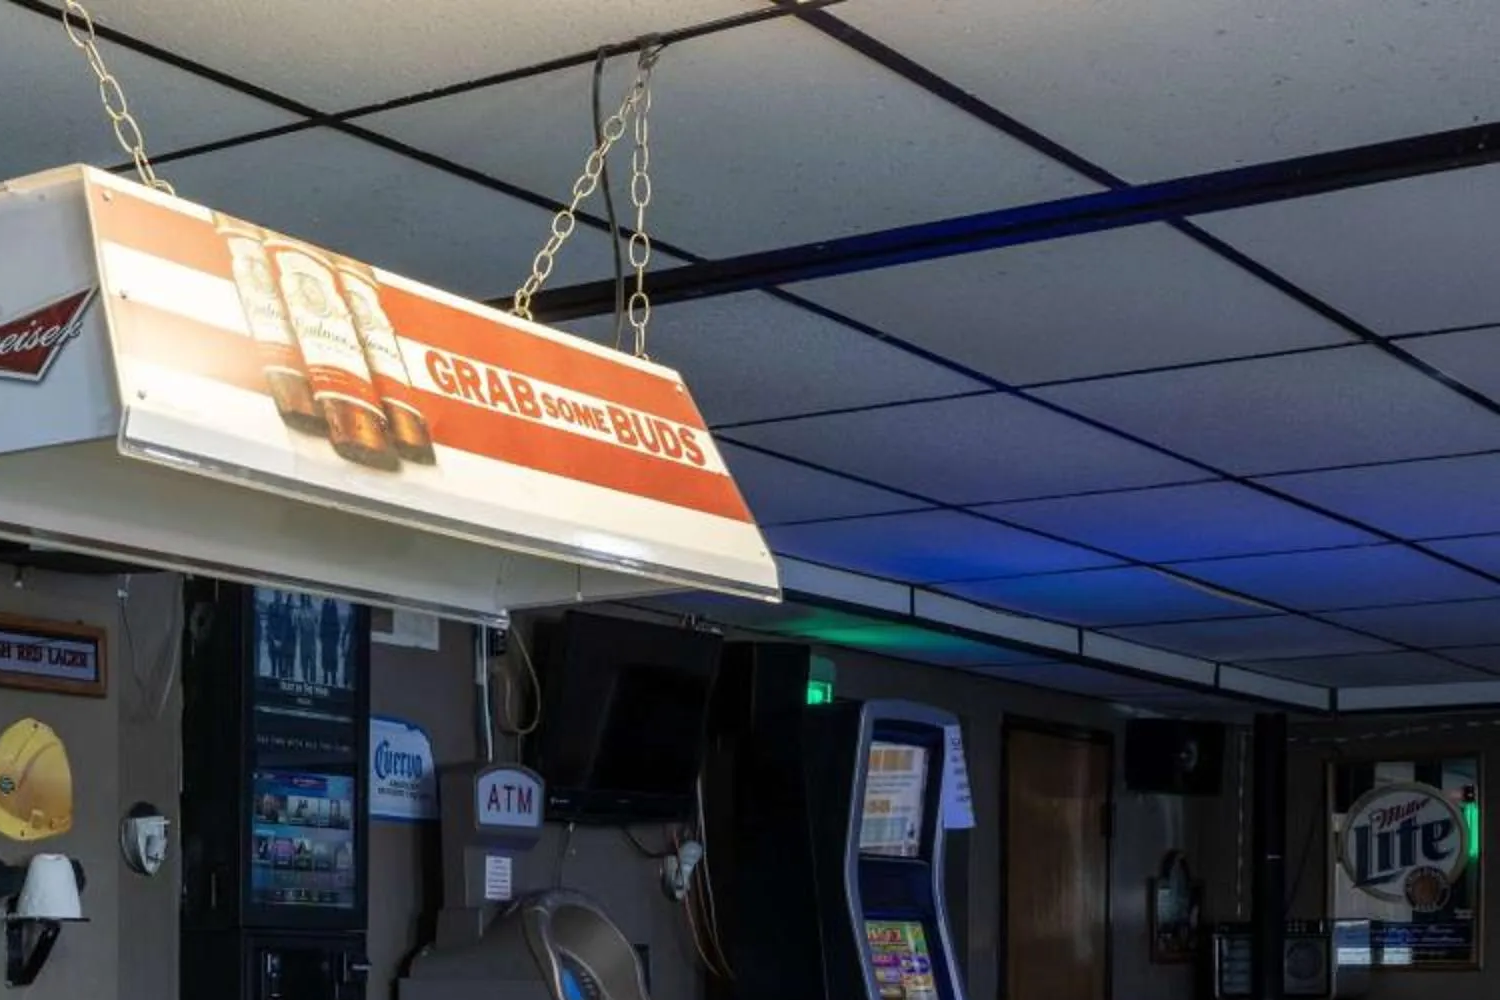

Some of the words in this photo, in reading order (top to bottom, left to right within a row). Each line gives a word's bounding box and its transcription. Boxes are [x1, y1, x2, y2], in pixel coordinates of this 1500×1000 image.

[423, 347, 542, 420] GRAB
[541, 391, 613, 435] SOME
[610, 406, 707, 468] BUDS
[486, 783, 534, 815] ATM
[1352, 817, 1458, 890] Lite
